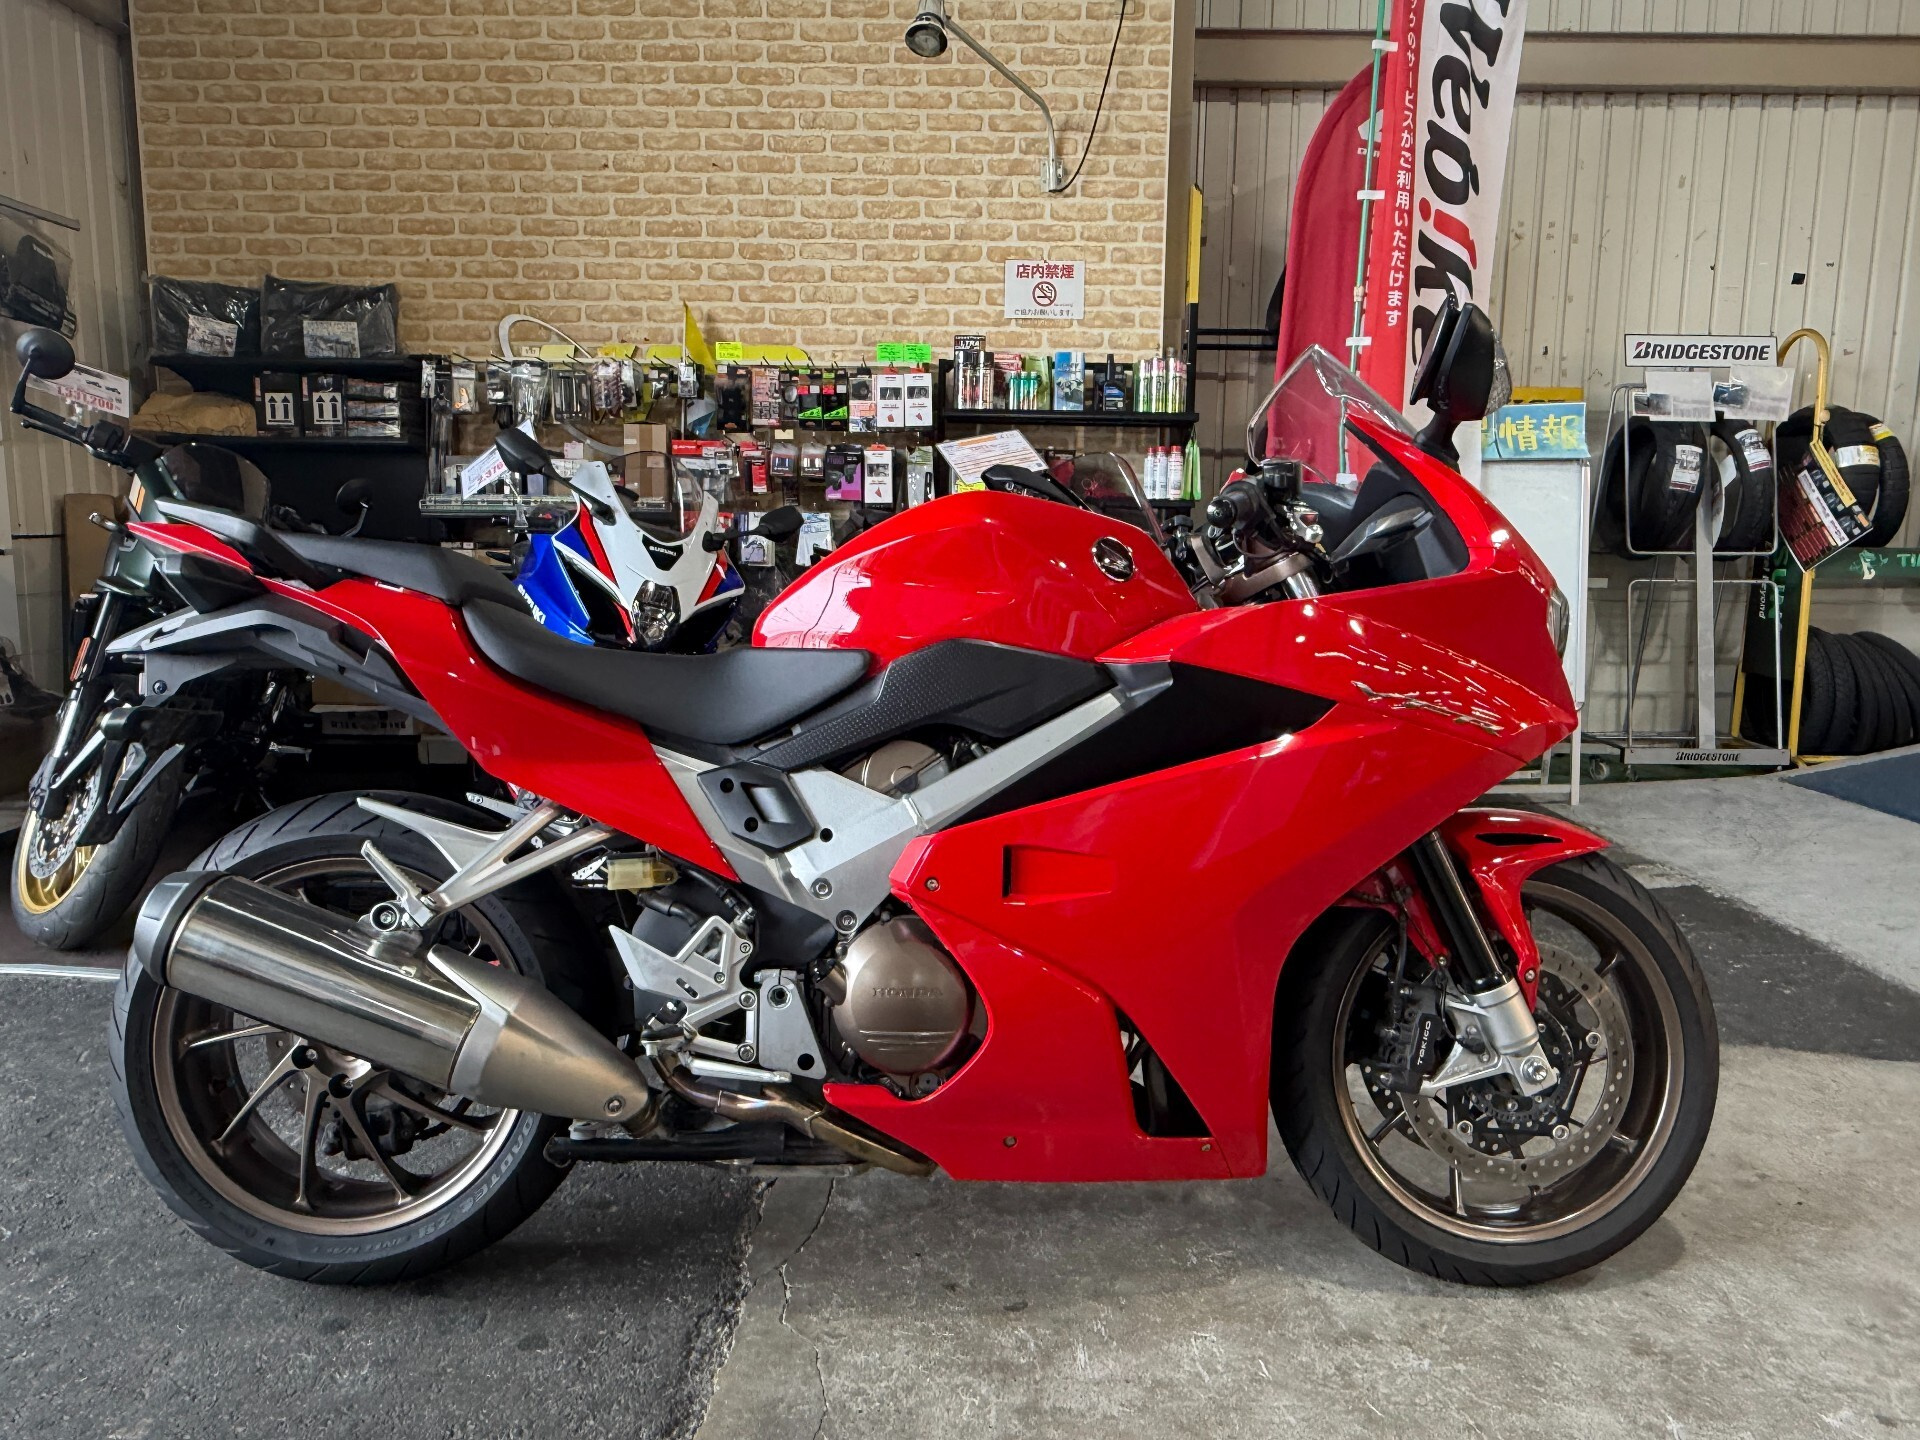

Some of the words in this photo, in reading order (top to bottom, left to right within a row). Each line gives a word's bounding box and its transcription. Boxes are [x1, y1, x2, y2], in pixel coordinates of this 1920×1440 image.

[1016, 264, 1075, 279] 店内禁煙
[1633, 341, 1771, 360] BRIDGESTONE
[648, 545, 677, 557] SUZUKI
[1675, 751, 1741, 762] BRIDGESTONE
[1416, 1020, 1431, 1066] TOKICO
[461, 1111, 537, 1214] OADTEC
